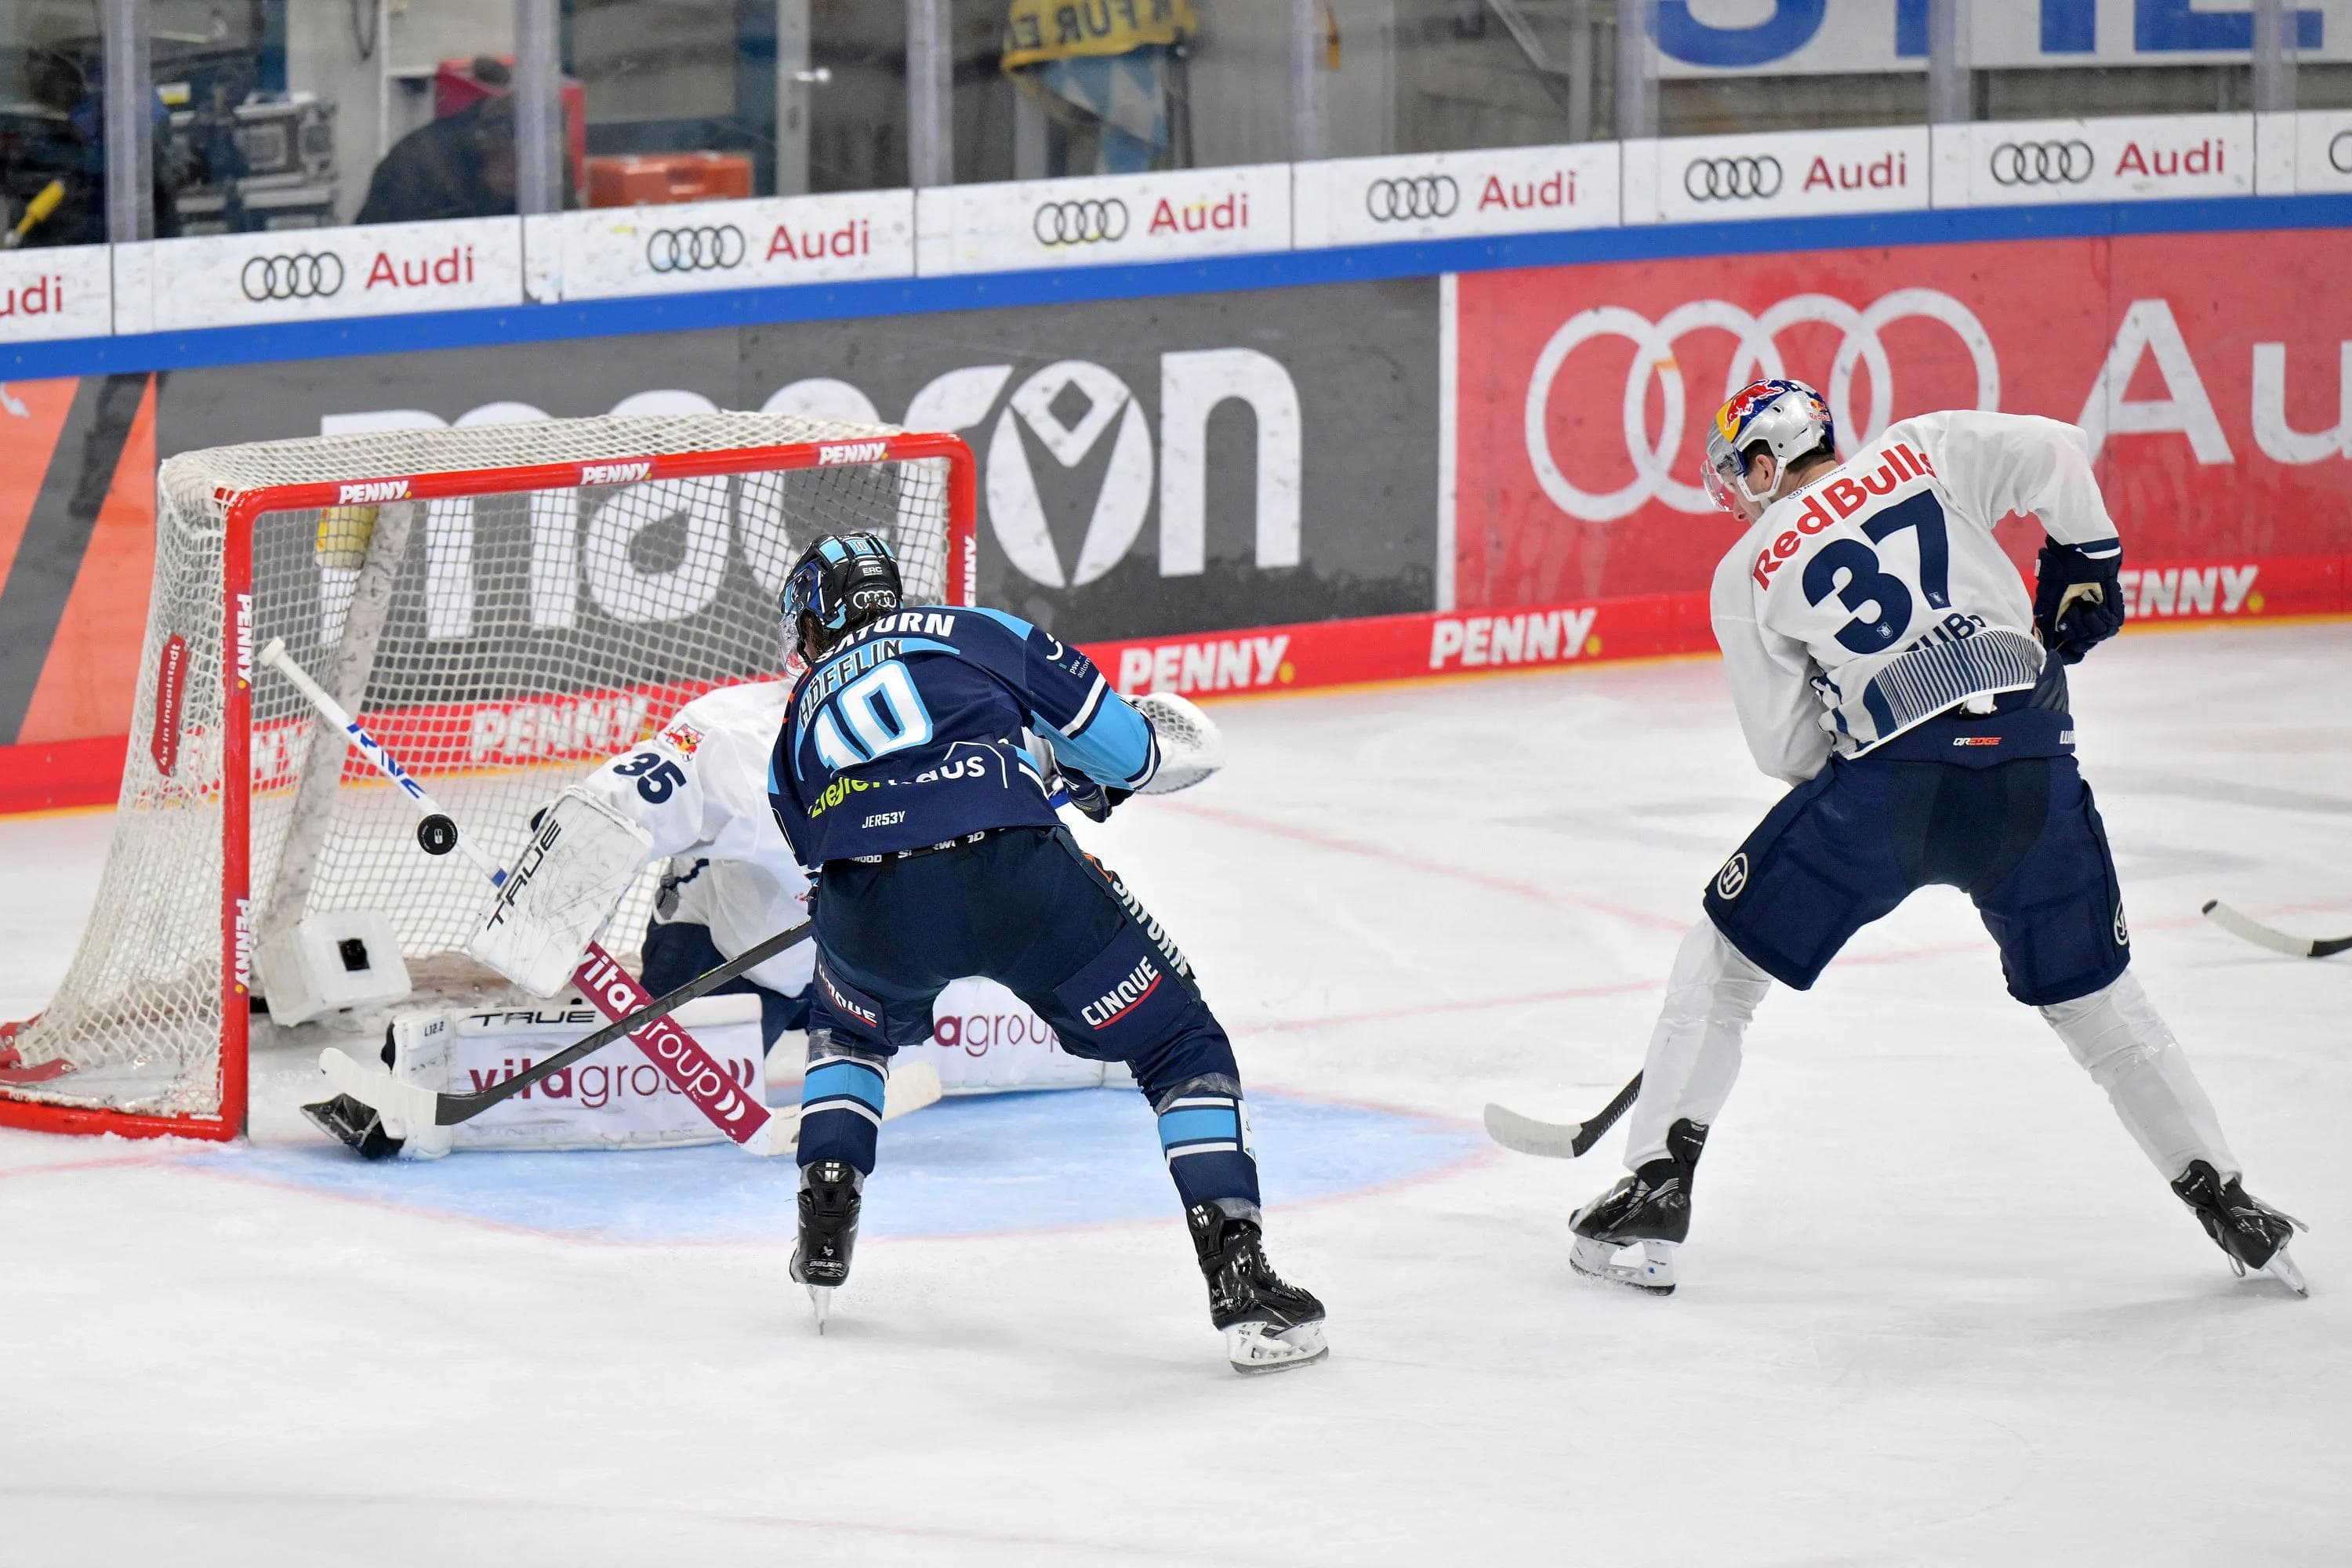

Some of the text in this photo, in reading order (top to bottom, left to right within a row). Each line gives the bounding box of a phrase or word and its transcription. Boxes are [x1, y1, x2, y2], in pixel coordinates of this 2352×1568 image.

[1804, 154, 1907, 191] Audi
[2116, 140, 2225, 176] Audi
[1149, 194, 1249, 234] Audi
[1479, 171, 1577, 212] Audi
[766, 220, 869, 261] Audi
[366, 245, 475, 289] Audi
[854, 541, 869, 552] 10
[1802, 488, 1951, 654] 37
[815, 612, 956, 664] SATURN
[159, 643, 181, 767] 4x in Ingolstadt
[800, 638, 904, 731] HÖFFLIN
[814, 659, 934, 770] 10
[614, 752, 687, 804] 35
[487, 818, 562, 931] TRUE
[1081, 955, 1159, 1026] CINQUE
[469, 1008, 596, 1027] TRUE
